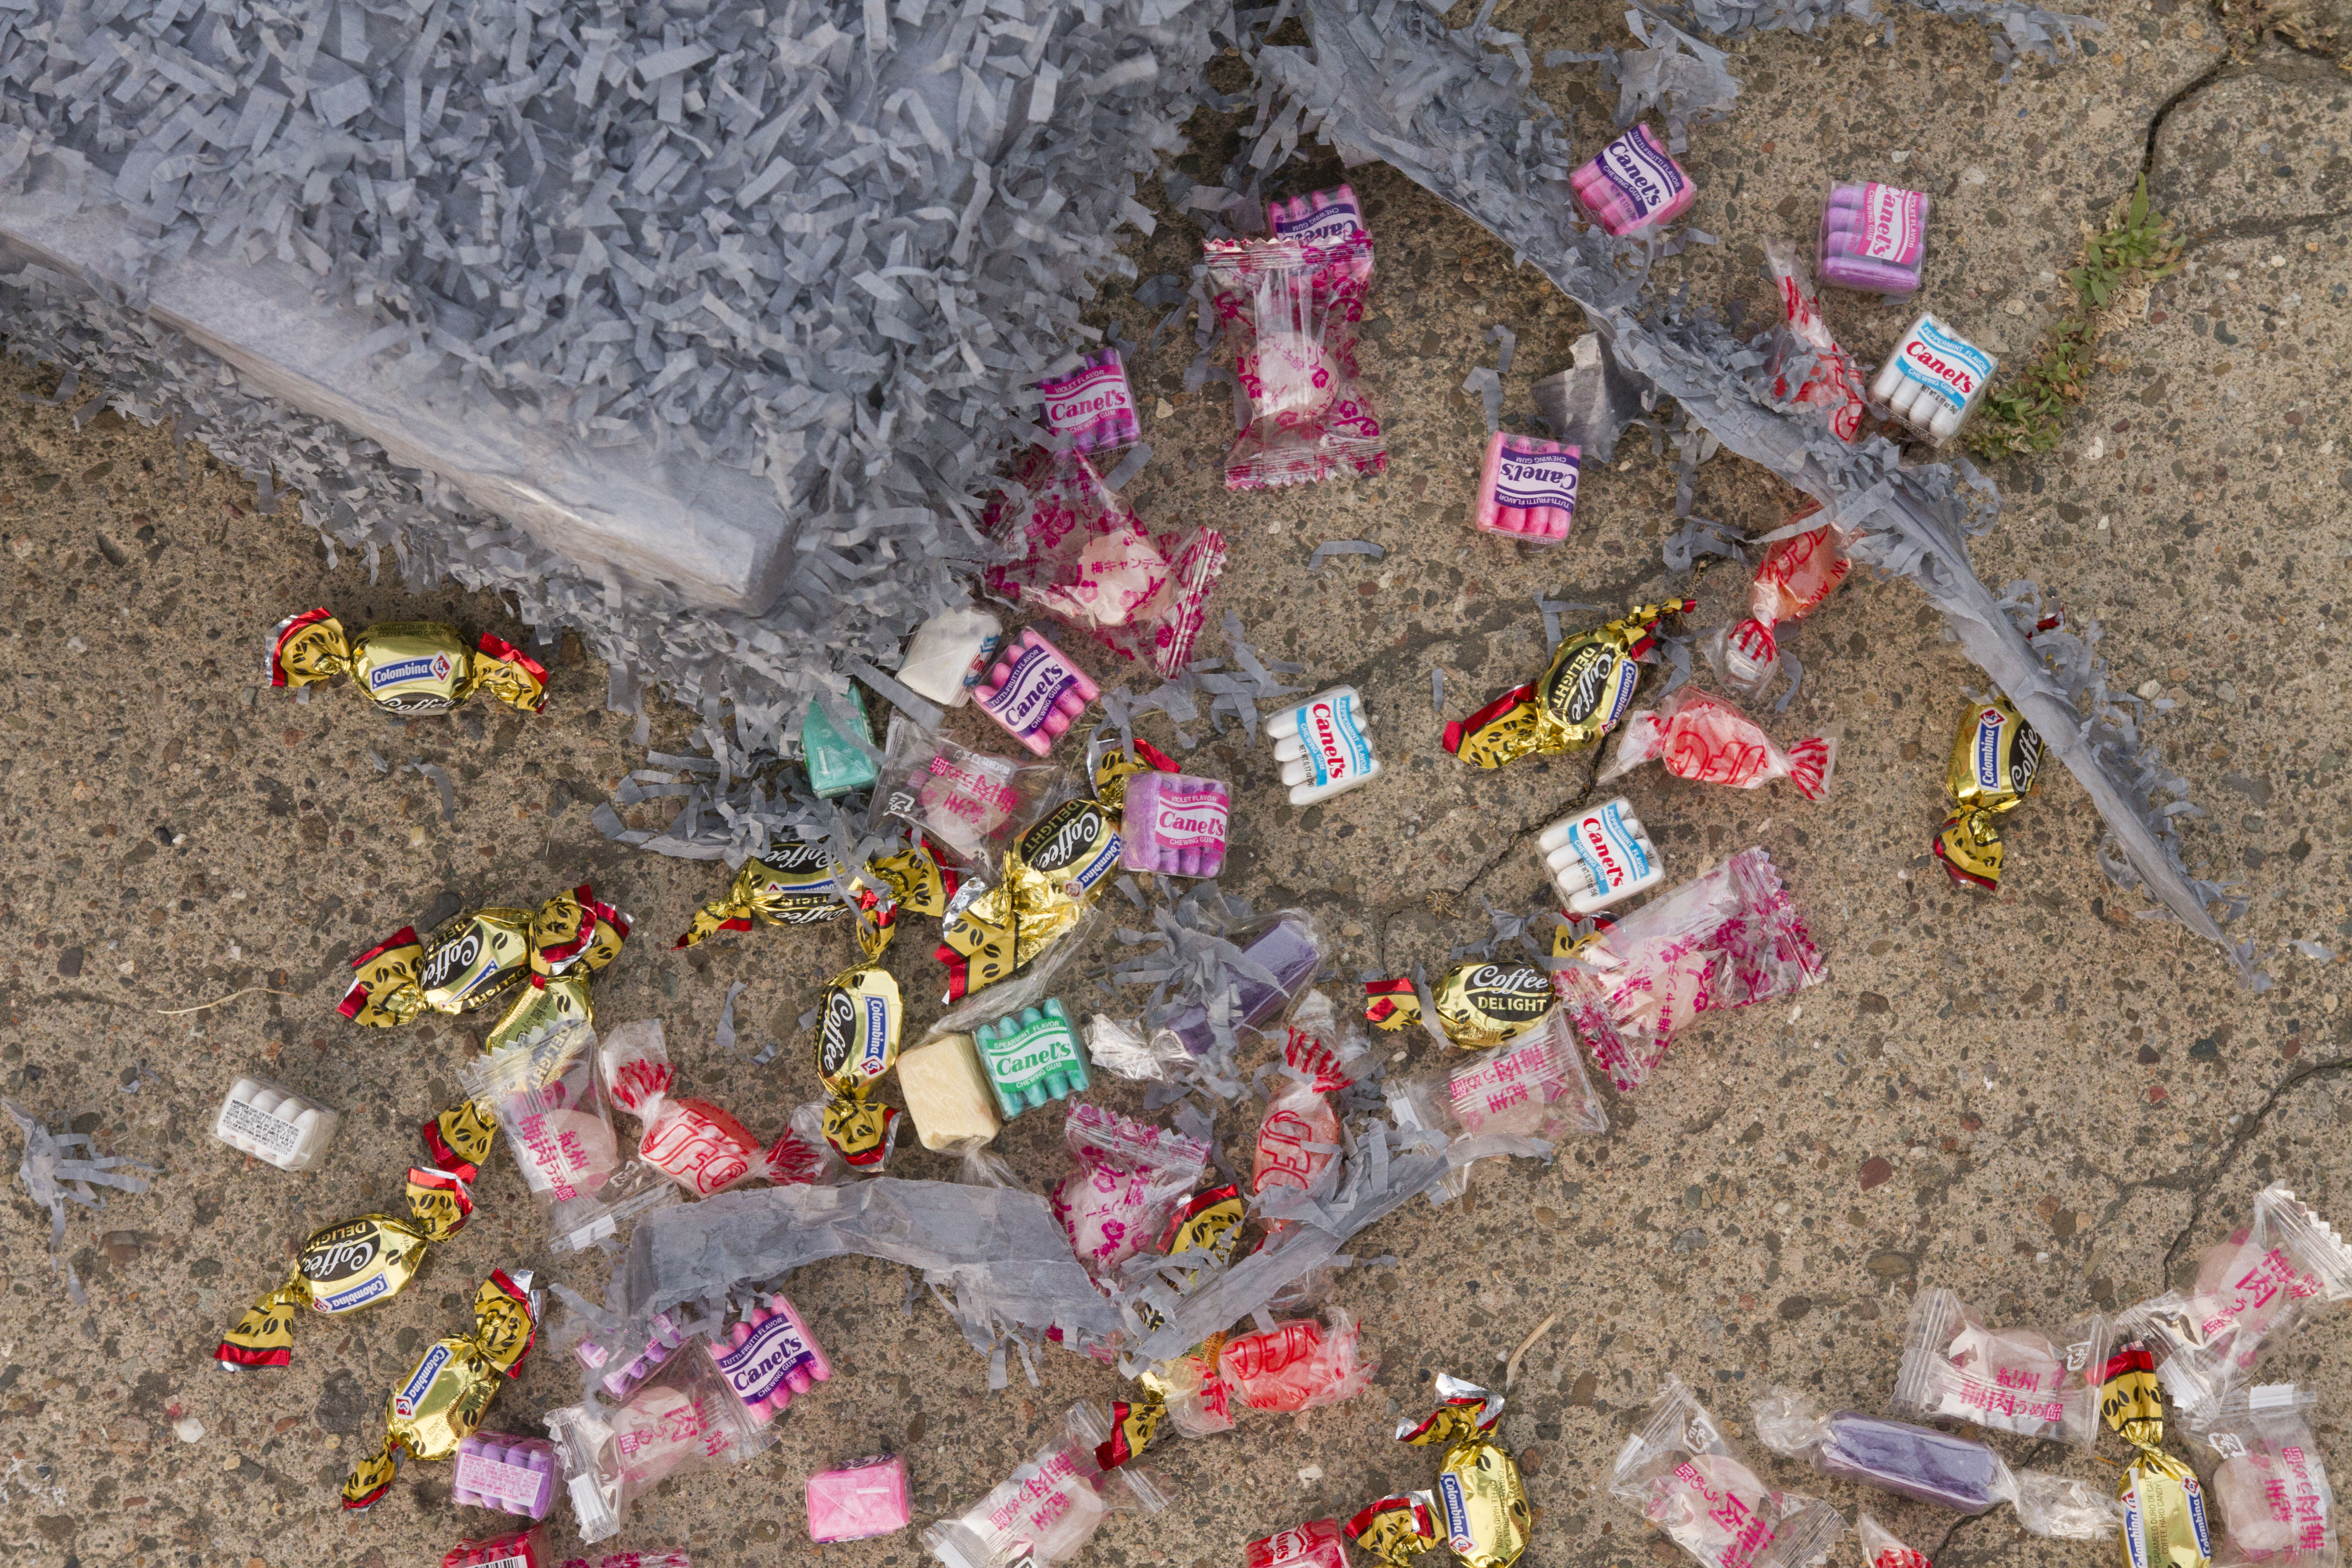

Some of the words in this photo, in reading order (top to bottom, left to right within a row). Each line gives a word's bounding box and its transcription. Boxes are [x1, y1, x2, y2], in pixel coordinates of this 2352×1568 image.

[1609, 141, 1661, 206] Canel's
[1633, 131, 1664, 166] TUTTI-FRUTTI
[1661, 164, 1680, 187] FLAVOR
[1603, 165, 1629, 189] CHEWING
[1629, 186, 1642, 202] GUM
[1310, 207, 1339, 225] CHEWING
[1867, 190, 1876, 223] CHEWING
[1872, 185, 1902, 257] Canel's
[1908, 195, 1918, 221] VIOLET
[1293, 222, 1309, 232] GUM
[1867, 224, 1875, 241] GUM
[1907, 222, 1917, 248] FLAVOR
[1923, 327, 1963, 353] PEPPERMINT
[1965, 350, 1987, 372] FLAVOR
[1054, 380, 1077, 393] VIOLET
[1078, 370, 1105, 384] FLAVOR
[1906, 341, 1975, 393] Canel's
[1908, 368, 1940, 387] CHEWING
[1940, 382, 1955, 395] GUM
[1920, 383, 1931, 393] NET
[1050, 389, 1126, 421] Canel's
[1069, 415, 1100, 433] CHEWING
[1101, 409, 1116, 418] GUM
[1500, 463, 1577, 490] Canel's
[1499, 494, 1525, 505] FLAVOR
[1526, 497, 1569, 509] TUTTI-FRUTTI
[373, 664, 428, 682] Colombina
[990, 669, 1020, 706] TUTTI-FRUTTI
[1019, 649, 1039, 669] FLAVOR
[1552, 647, 1597, 708] DELIGHT
[1004, 664, 1063, 726] Canel's
[1031, 699, 1051, 729] CHEWING
[1050, 684, 1062, 699] GUM
[1614, 666, 1635, 722] Colombina
[1300, 723, 1317, 754] CHEWING
[1317, 754, 1325, 770] GUM
[1313, 703, 1346, 779] Canel's
[1340, 700, 1359, 744] PEPPERMINT
[1357, 744, 1368, 772] FLAVOR
[1298, 744, 1306, 754] NET
[1305, 777, 1316, 788] (5g)
[1982, 729, 1995, 784] Colombina
[2011, 727, 2038, 793] Coffe
[1171, 795, 1191, 803] VIOLET
[1027, 799, 1081, 853] DELIGHT
[1040, 812, 1099, 868] Coffee
[1159, 810, 1225, 837] Canel's
[1170, 837, 1199, 846] CHEWING
[1583, 818, 1624, 887] Canel's
[1607, 809, 1633, 849] PEPPERMINT
[1632, 849, 1646, 875] FLAVOR
[1080, 838, 1122, 885] Colombina
[1574, 840, 1597, 867] CHEWING
[1596, 865, 1605, 881] GUM
[1576, 857, 1587, 868] NET
[1588, 887, 1599, 898] (5g)
[776, 905, 849, 924] Coffee
[1472, 965, 1548, 995] Coffee
[508, 994, 532, 1027] CARAMELO
[1477, 995, 1547, 1012] DELIGHT
[494, 1019, 509, 1037] HARD
[498, 1026, 512, 1044] DURO
[823, 993, 854, 1071] Coffee
[869, 1000, 883, 1054] Colombina
[994, 1029, 1030, 1050] SPEARMINT
[1033, 1020, 1059, 1032] FLAVOR
[529, 1025, 571, 1090] DELIGHT
[996, 1041, 1071, 1077] Canel's
[1015, 1069, 1046, 1089] CHEWING
[1045, 1061, 1062, 1073] GUM
[1486, 1082, 1530, 1114] 紀州
[555, 1128, 590, 1171] 紀州
[303, 1239, 373, 1278] Coffee
[332, 1279, 385, 1308] Colombina
[722, 1333, 760, 1366] TUTTI-FRUTTI
[758, 1318, 783, 1334] FLAVOR
[406, 1348, 448, 1400] Colombina
[732, 1336, 803, 1391] Canel's
[757, 1373, 784, 1398] CHEWING
[782, 1357, 798, 1372] GUM
[1996, 1366, 2040, 1392] 紀州
[439, 1400, 455, 1419] HARD
[1959, 1378, 2063, 1421] 梅肉うめ飴
[425, 1416, 443, 1437] CANDY
[438, 1425, 448, 1435] DE
[1443, 1477, 1464, 1533] Colombina
[1489, 1479, 1499, 1504] COFFEE
[1497, 1470, 1507, 1508] CARAMELO
[2148, 1494, 2155, 1502] DE
[2155, 1483, 2164, 1507] CANDY
[1029, 1490, 1073, 1532] 紀州
[1491, 1505, 1500, 1524] HARD
[1500, 1508, 1509, 1529] DURO
[2158, 1508, 2166, 1527] HARD
[2193, 1499, 2209, 1553] Colombina
[1494, 1525, 1503, 1548] CANDY
[1503, 1529, 1509, 1538] DE
[2152, 1526, 2161, 1563] CARAMELO
[2160, 1529, 2169, 1554] COFFEE
